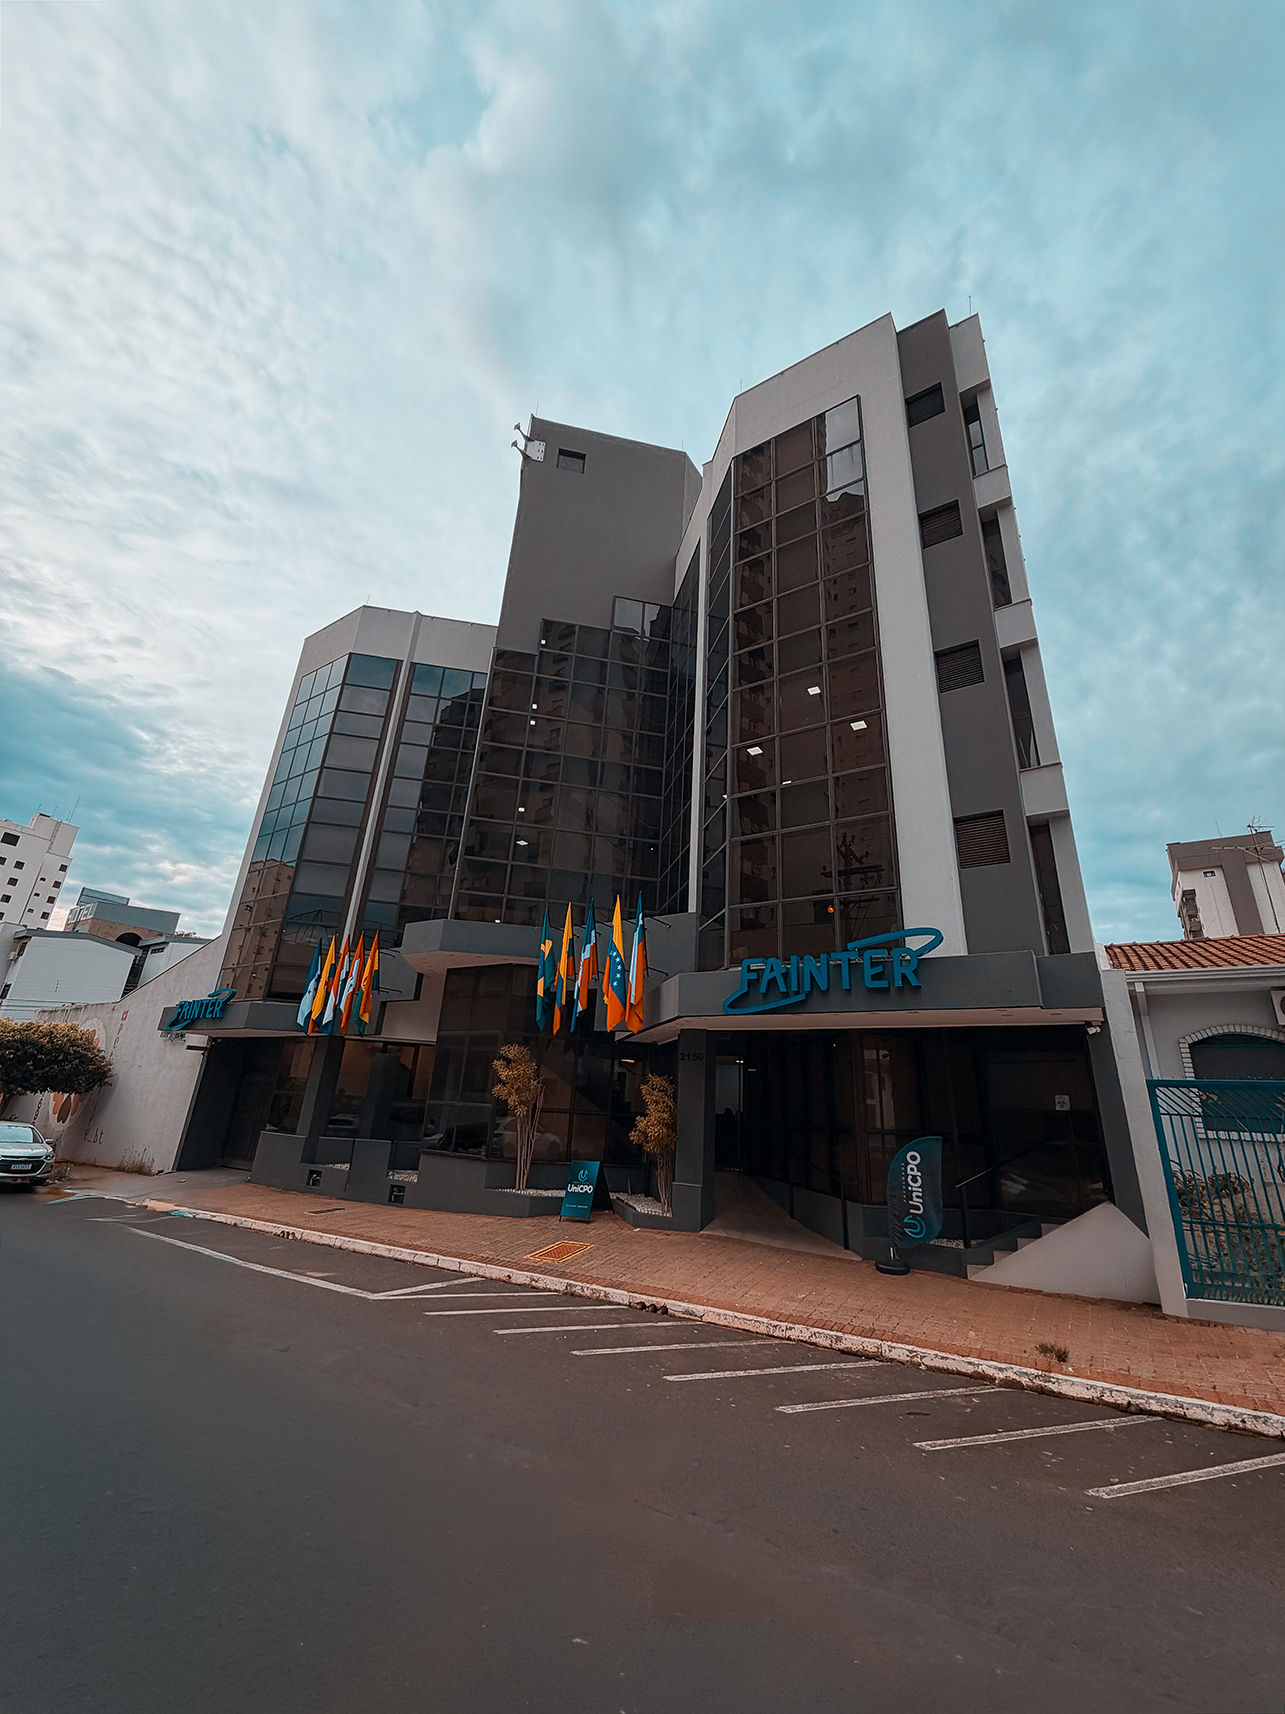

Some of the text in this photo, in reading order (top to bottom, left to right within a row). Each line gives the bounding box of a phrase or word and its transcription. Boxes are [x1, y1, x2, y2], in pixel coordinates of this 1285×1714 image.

[680, 1052, 704, 1061] 2150
[567, 1183, 594, 1194] UniCPO
[906, 1151, 924, 1215] UniCPO
